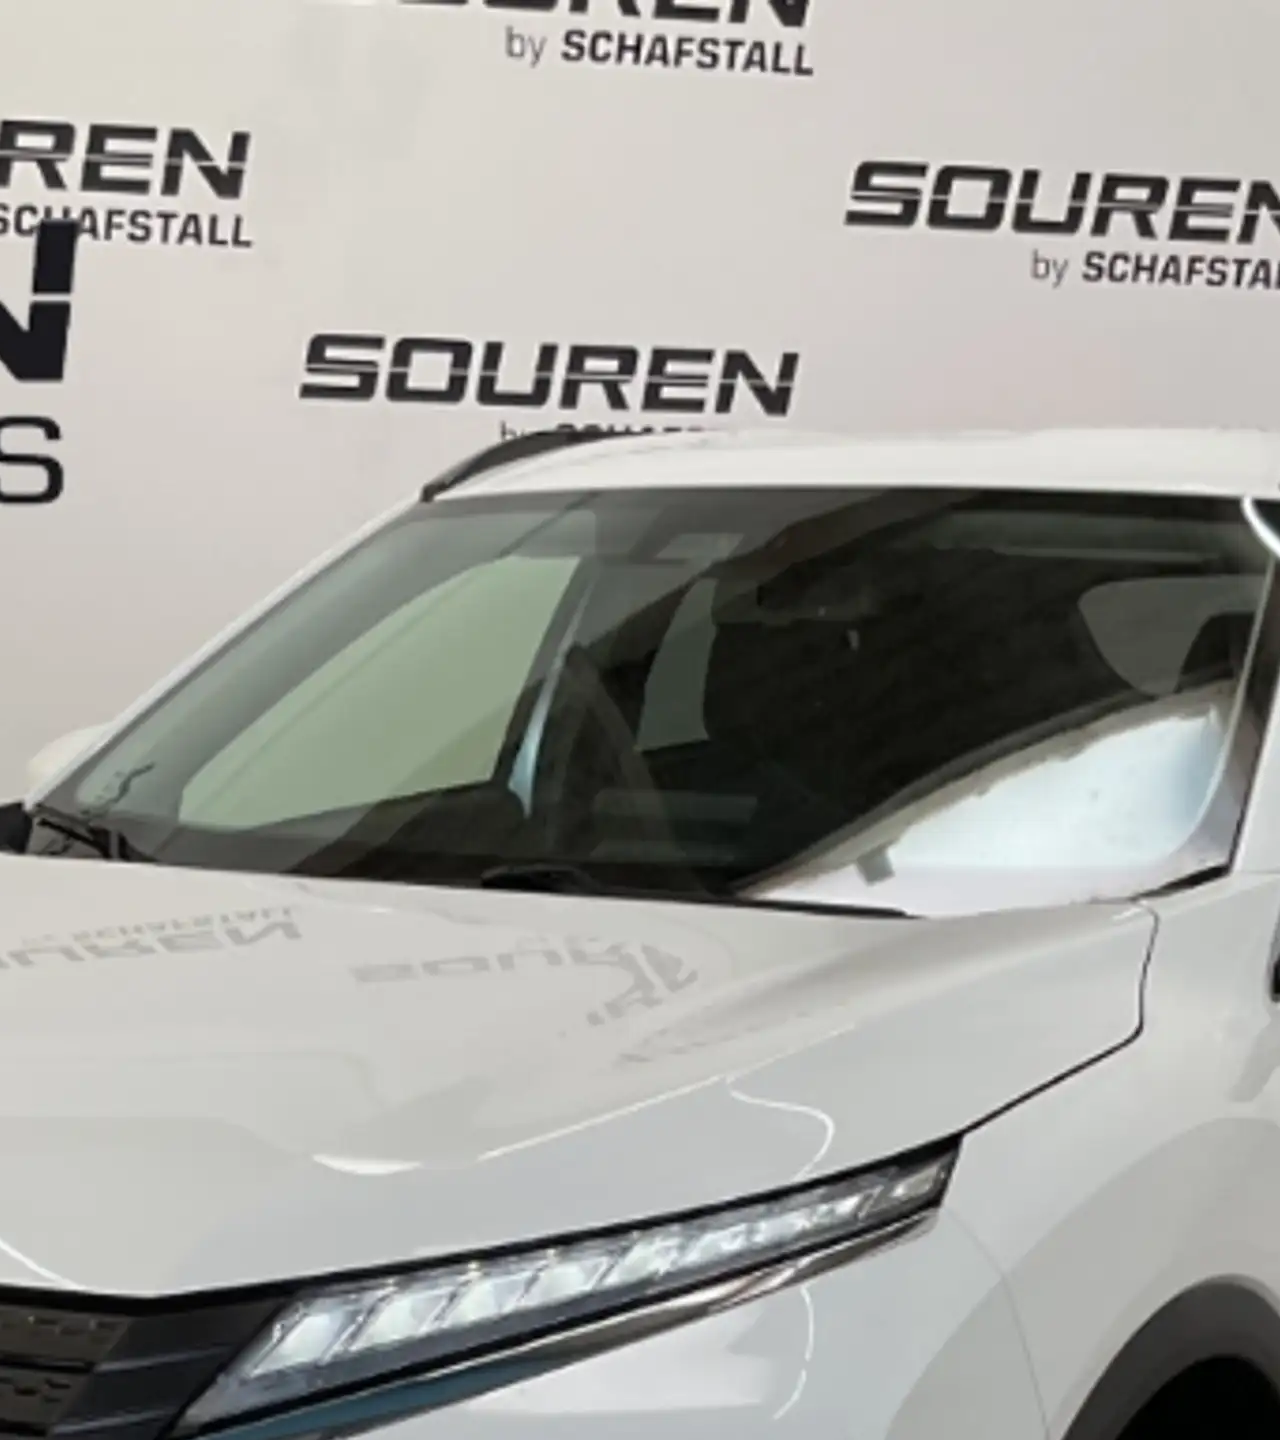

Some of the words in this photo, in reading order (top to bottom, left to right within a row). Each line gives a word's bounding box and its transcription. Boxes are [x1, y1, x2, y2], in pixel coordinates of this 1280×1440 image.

[505, 26, 547, 68] by
[561, 30, 814, 76] SCHAFSTALL
[1031, 249, 1069, 288] by
[299, 333, 800, 417] SOUREN
